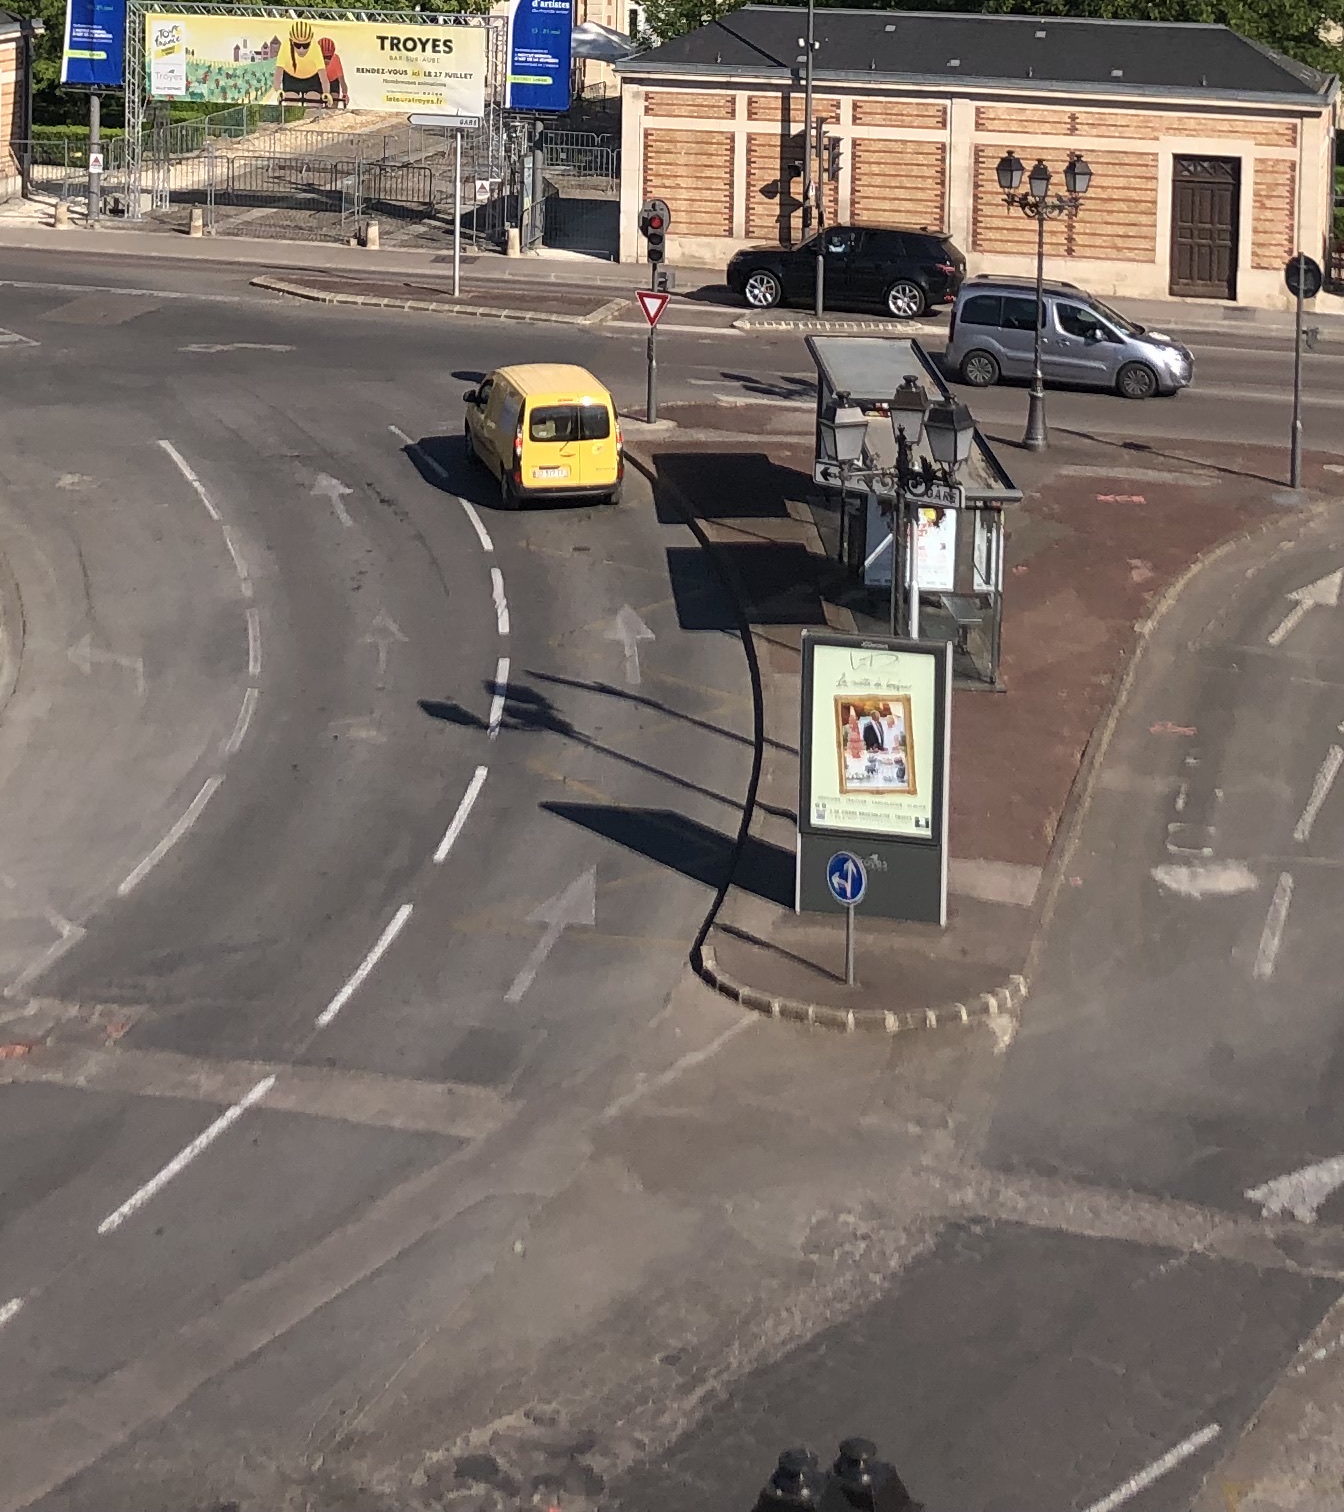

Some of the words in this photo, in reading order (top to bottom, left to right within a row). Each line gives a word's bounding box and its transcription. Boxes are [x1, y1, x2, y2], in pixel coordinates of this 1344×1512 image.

[376, 35, 454, 54] TROYES
[356, 67, 408, 76] RENDEZ-VOUS
[423, 70, 433, 78] LE
[444, 72, 473, 81] JUILLET
[927, 488, 957, 504] GARE
